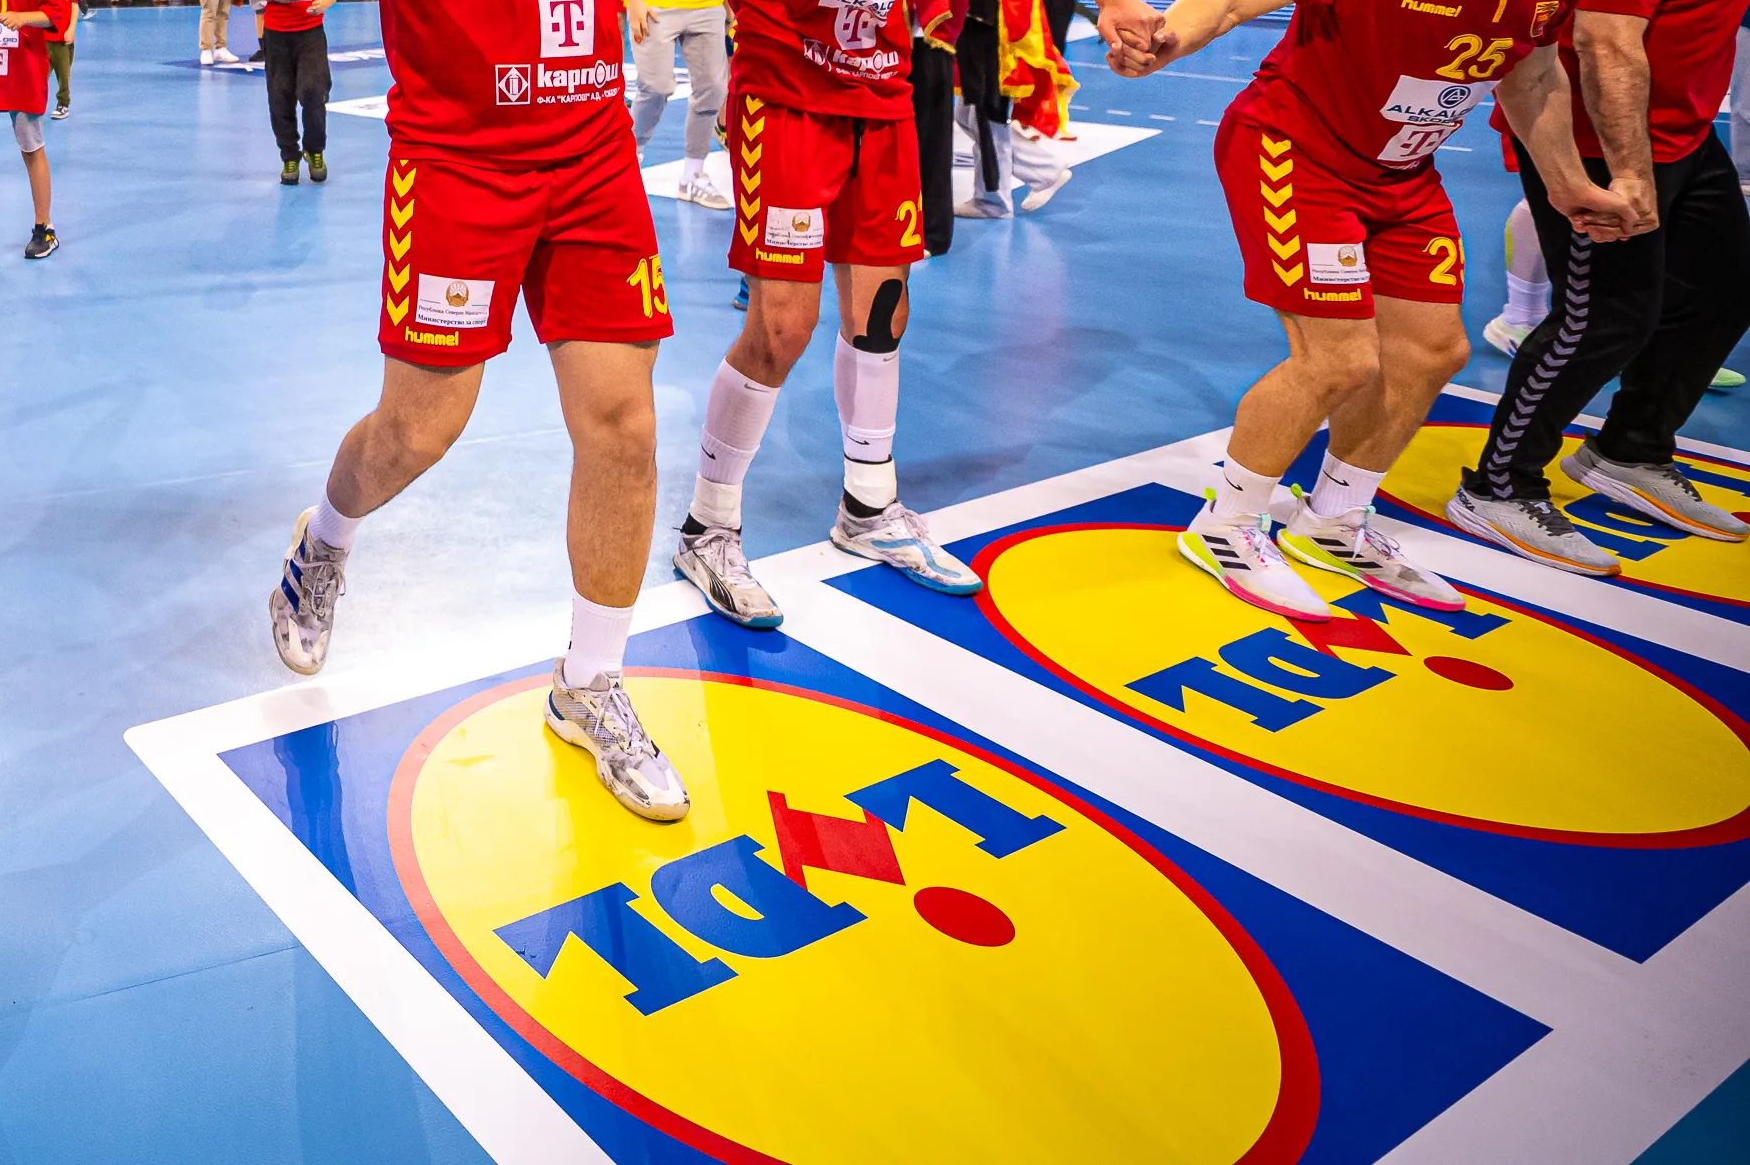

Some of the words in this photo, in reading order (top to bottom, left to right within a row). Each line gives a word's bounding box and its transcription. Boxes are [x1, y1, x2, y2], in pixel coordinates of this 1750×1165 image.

[550, 0, 585, 47] T
[1435, 33, 1514, 81] 25
[895, 193, 922, 247] 2
[755, 247, 804, 265] hummel
[1422, 236, 1465, 286] 2
[626, 253, 668, 318] 15
[1303, 287, 1362, 302] hummel
[405, 326, 460, 346] hummel
